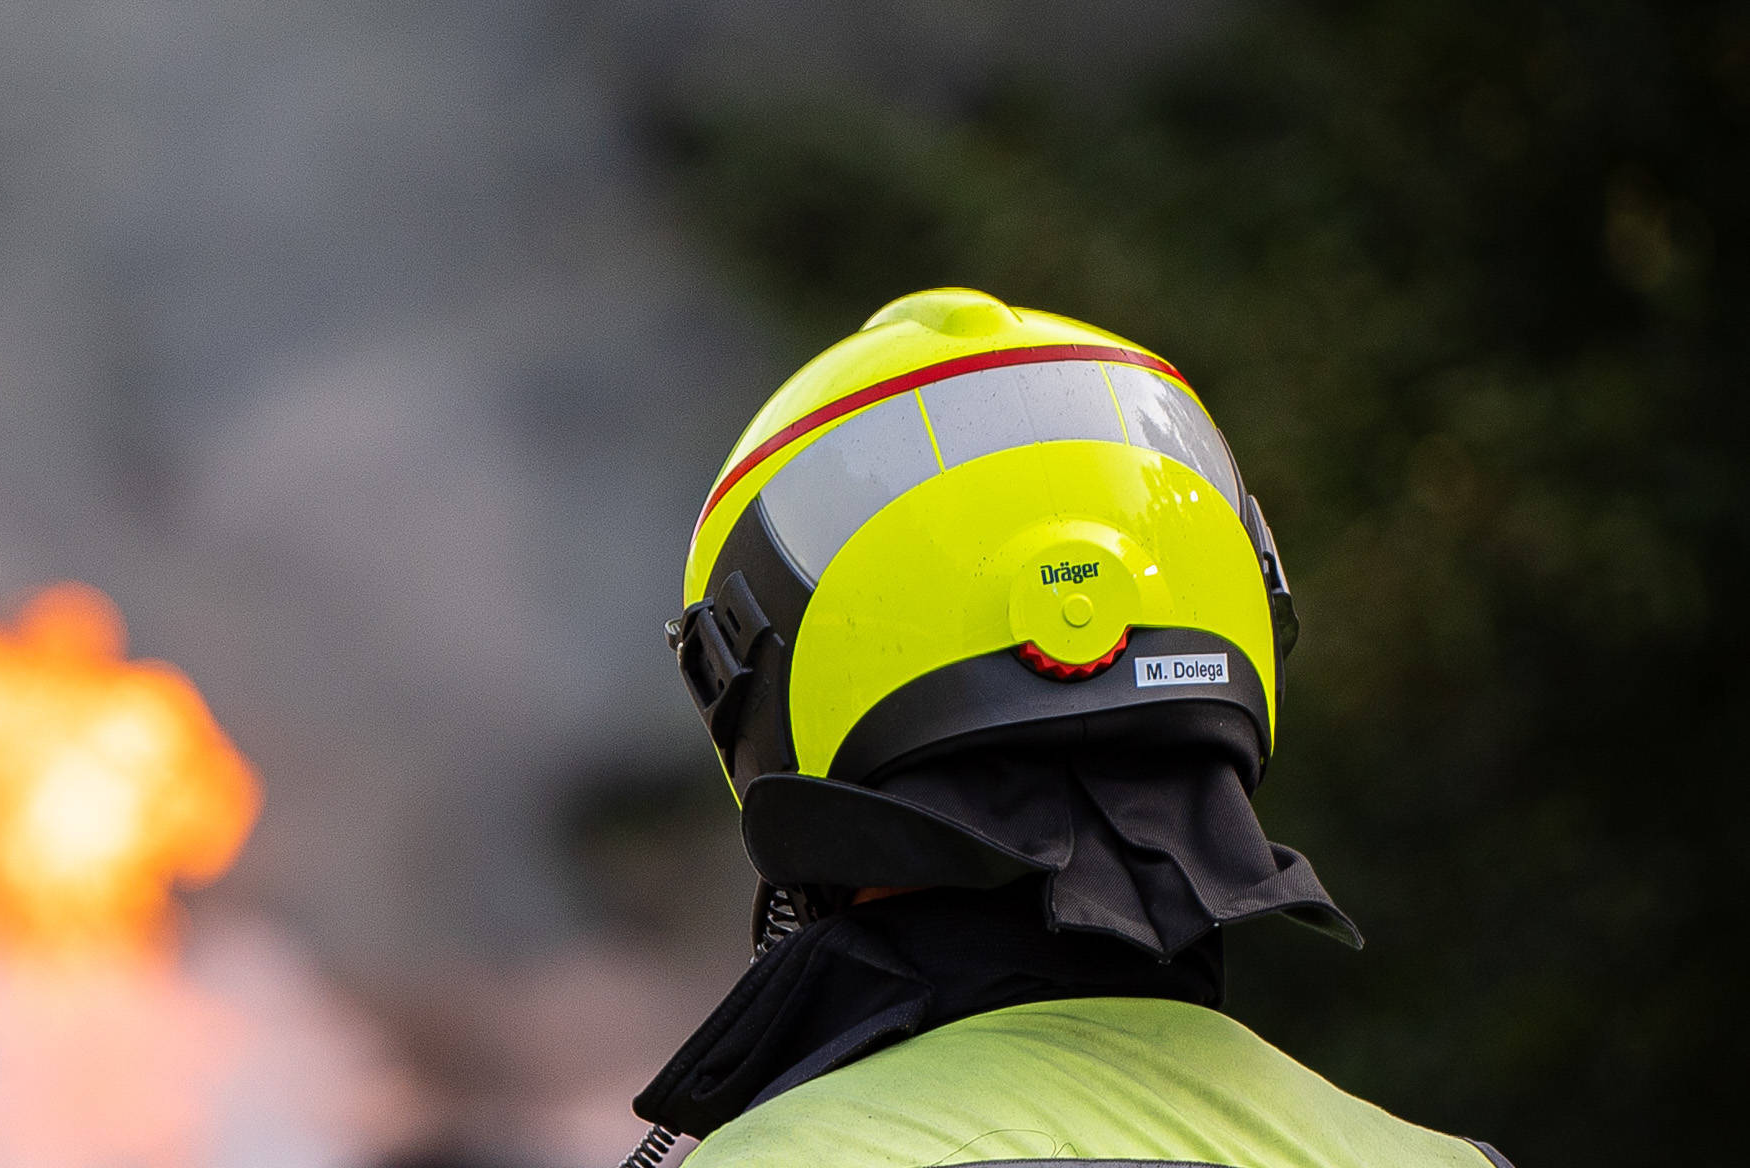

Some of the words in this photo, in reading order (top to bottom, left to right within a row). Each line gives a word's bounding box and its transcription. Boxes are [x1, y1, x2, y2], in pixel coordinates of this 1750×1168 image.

[1040, 562, 1099, 585] Dräger
[1146, 663, 1168, 681] M.
[1173, 661, 1223, 682] Dolega
